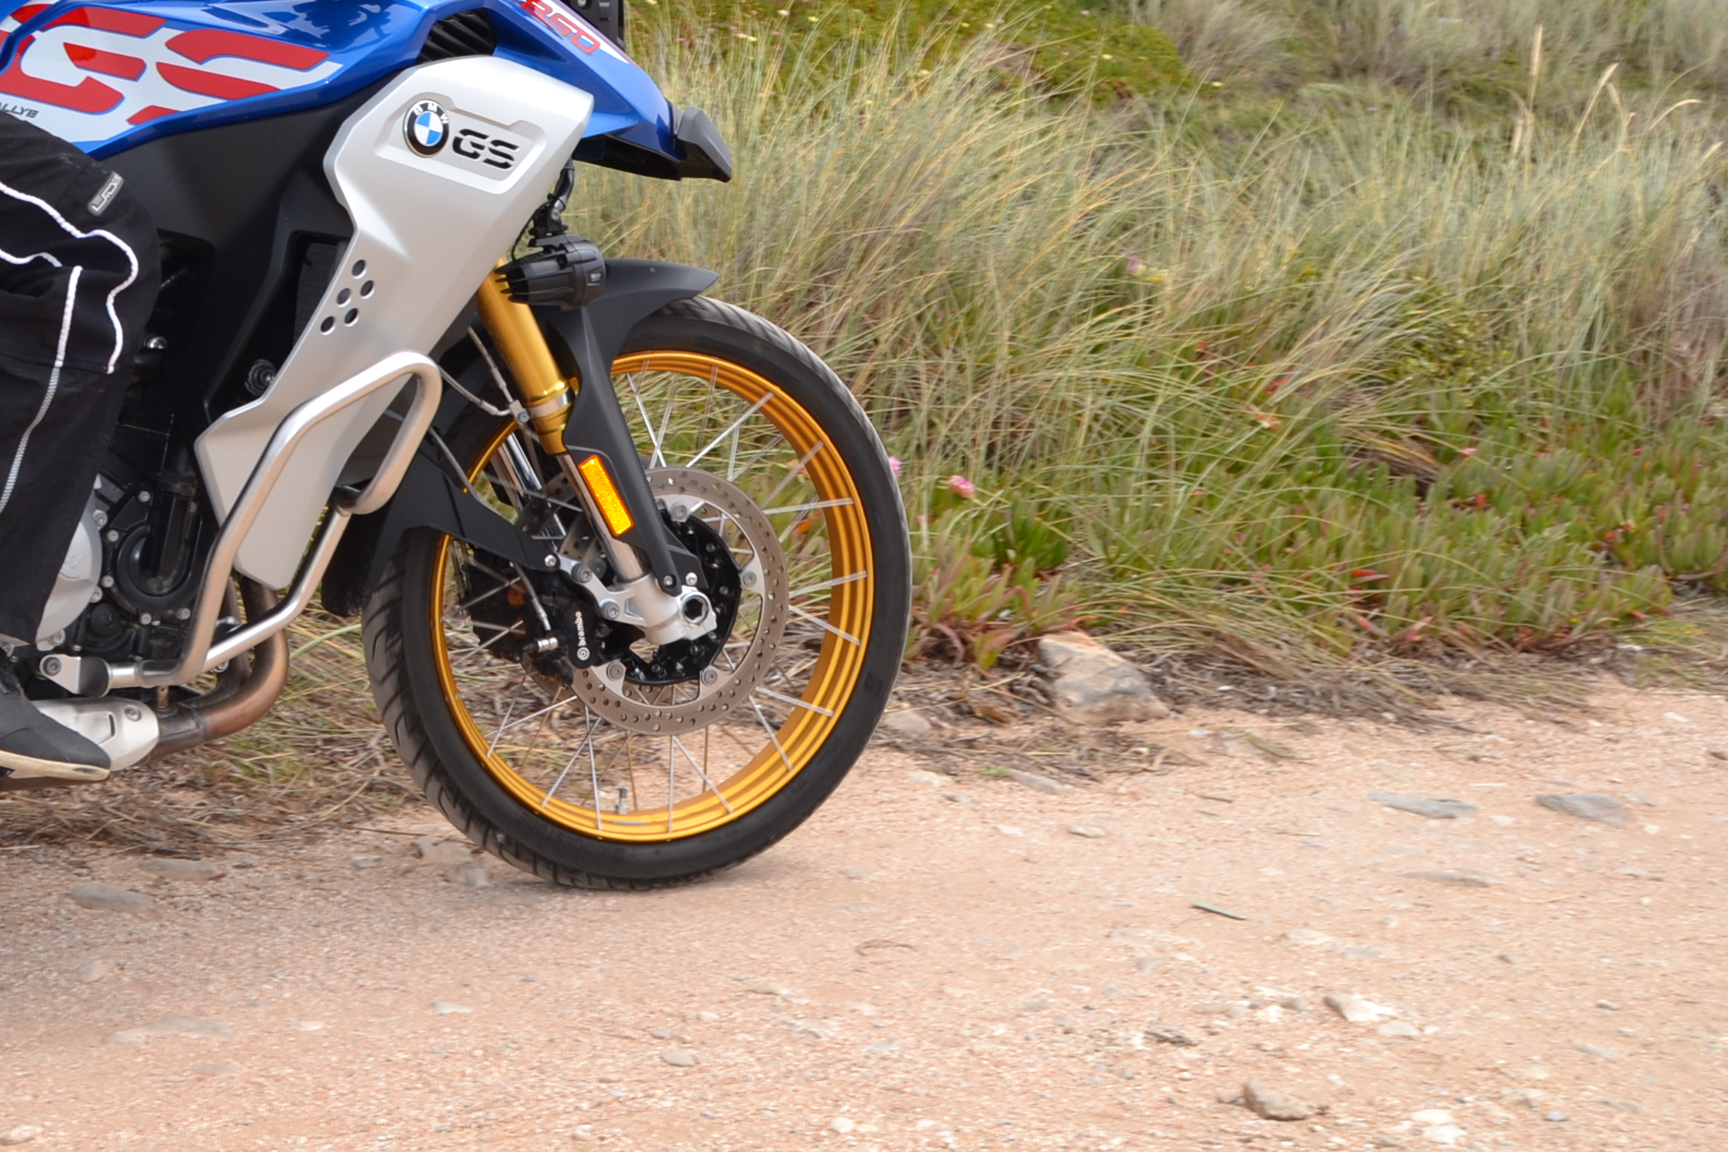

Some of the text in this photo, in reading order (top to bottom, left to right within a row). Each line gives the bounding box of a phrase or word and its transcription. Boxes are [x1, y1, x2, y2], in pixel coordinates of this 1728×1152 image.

[412, 101, 450, 125] BMW
[452, 128, 520, 170] GS
[574, 610, 587, 647] brembo
